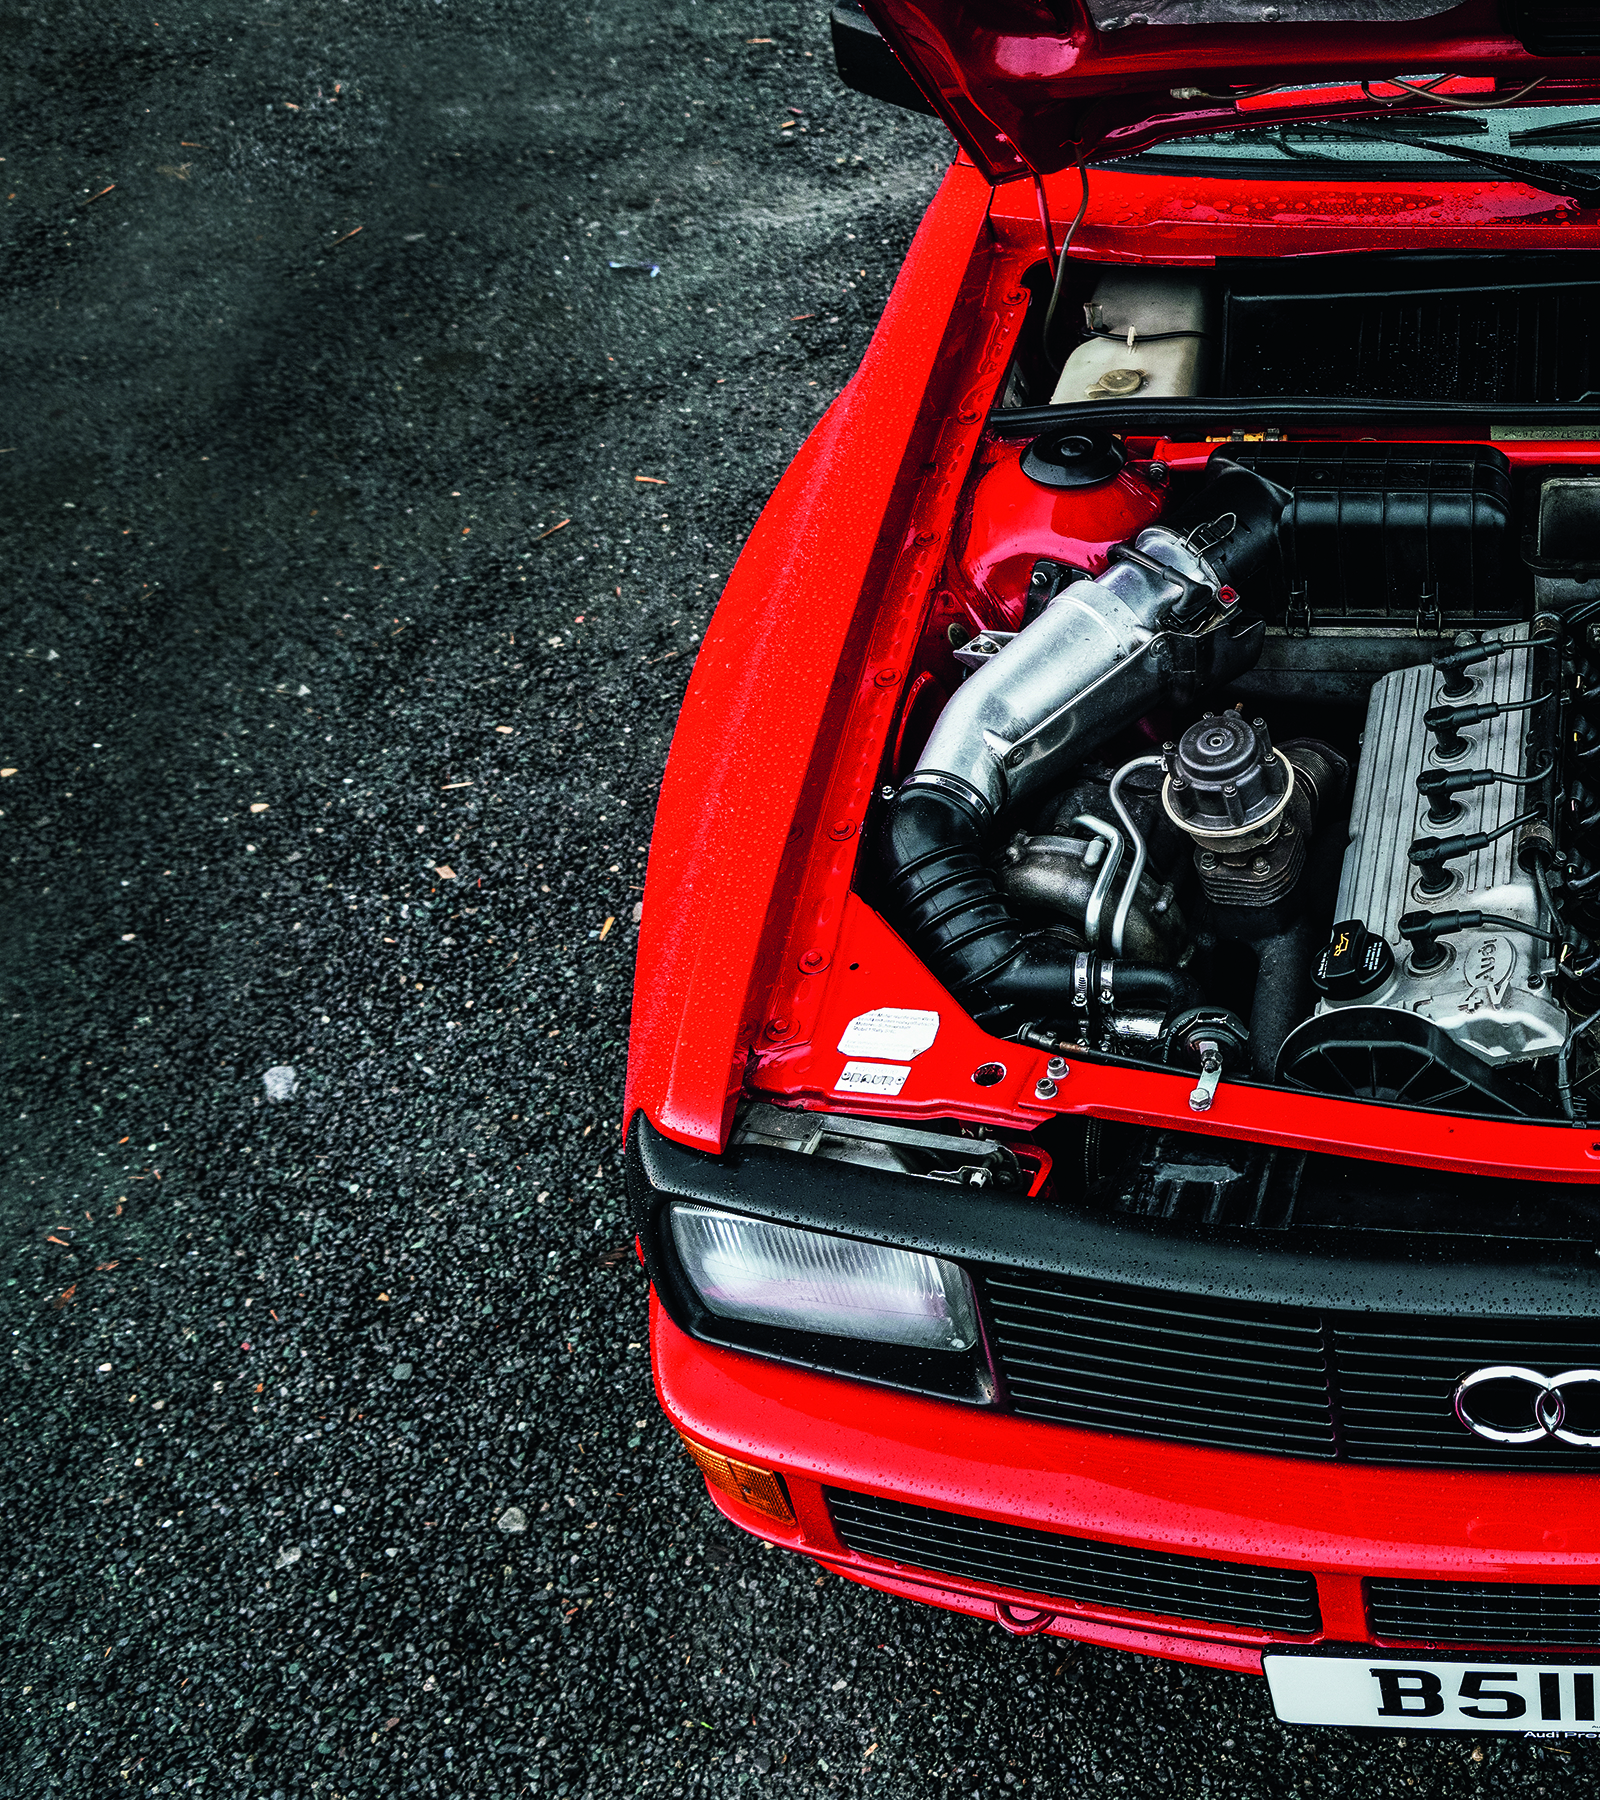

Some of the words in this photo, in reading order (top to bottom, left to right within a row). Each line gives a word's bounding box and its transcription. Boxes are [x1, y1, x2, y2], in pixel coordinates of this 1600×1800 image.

[1474, 935, 1499, 983] Audi
[1369, 1668, 1595, 1721] B511
[1523, 1731, 1560, 1739] Audi
